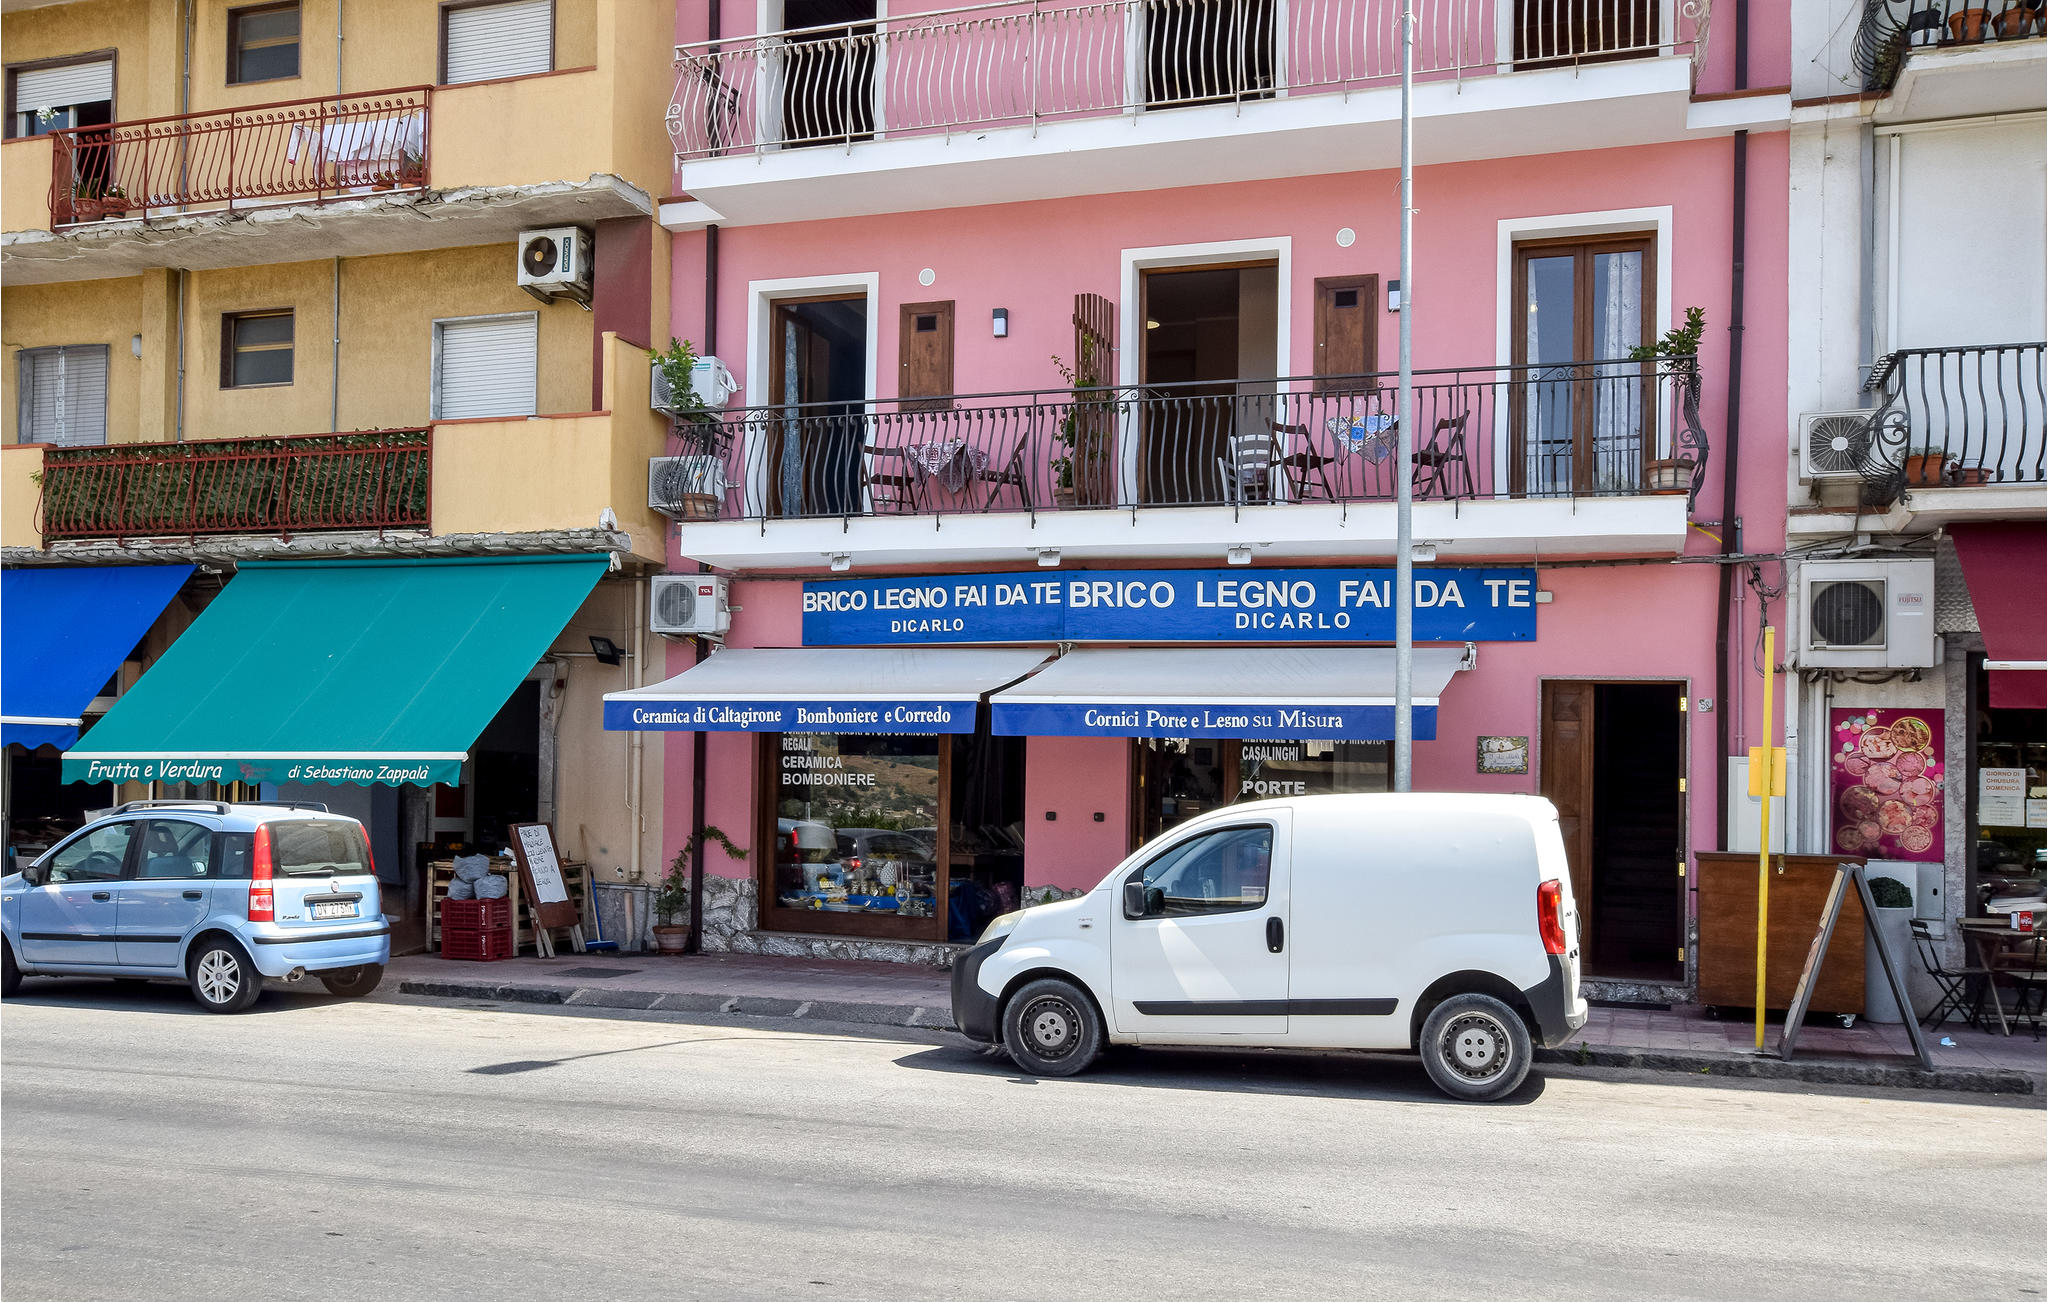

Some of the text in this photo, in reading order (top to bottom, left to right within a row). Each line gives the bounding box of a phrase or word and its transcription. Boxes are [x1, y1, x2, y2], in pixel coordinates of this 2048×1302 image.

[803, 582, 1061, 612] BRICO LEGNO FAI DA TE
[1069, 579, 1531, 608] BRICO LEGNO FAI DA TE
[891, 618, 964, 633] DICARLO
[1235, 612, 1350, 629] DICARLO
[632, 705, 951, 728] Ceramica di Caltagirone Bomboniere e Corredo
[1084, 709, 1344, 729] Cornici Porte e Legno su Misura
[782, 737, 812, 751] REGALI
[782, 756, 842, 768] CERAMICA
[1242, 746, 1299, 761] CASALINGHI
[88, 760, 139, 778] Frutta
[144, 766, 153, 777] e
[159, 760, 222, 778] Verdura
[288, 765, 301, 778] di
[303, 765, 373, 779] Sebastiano
[376, 765, 430, 783] Zappalà
[782, 773, 876, 786] BOMBONIERE
[1242, 780, 1305, 795] PORTE
